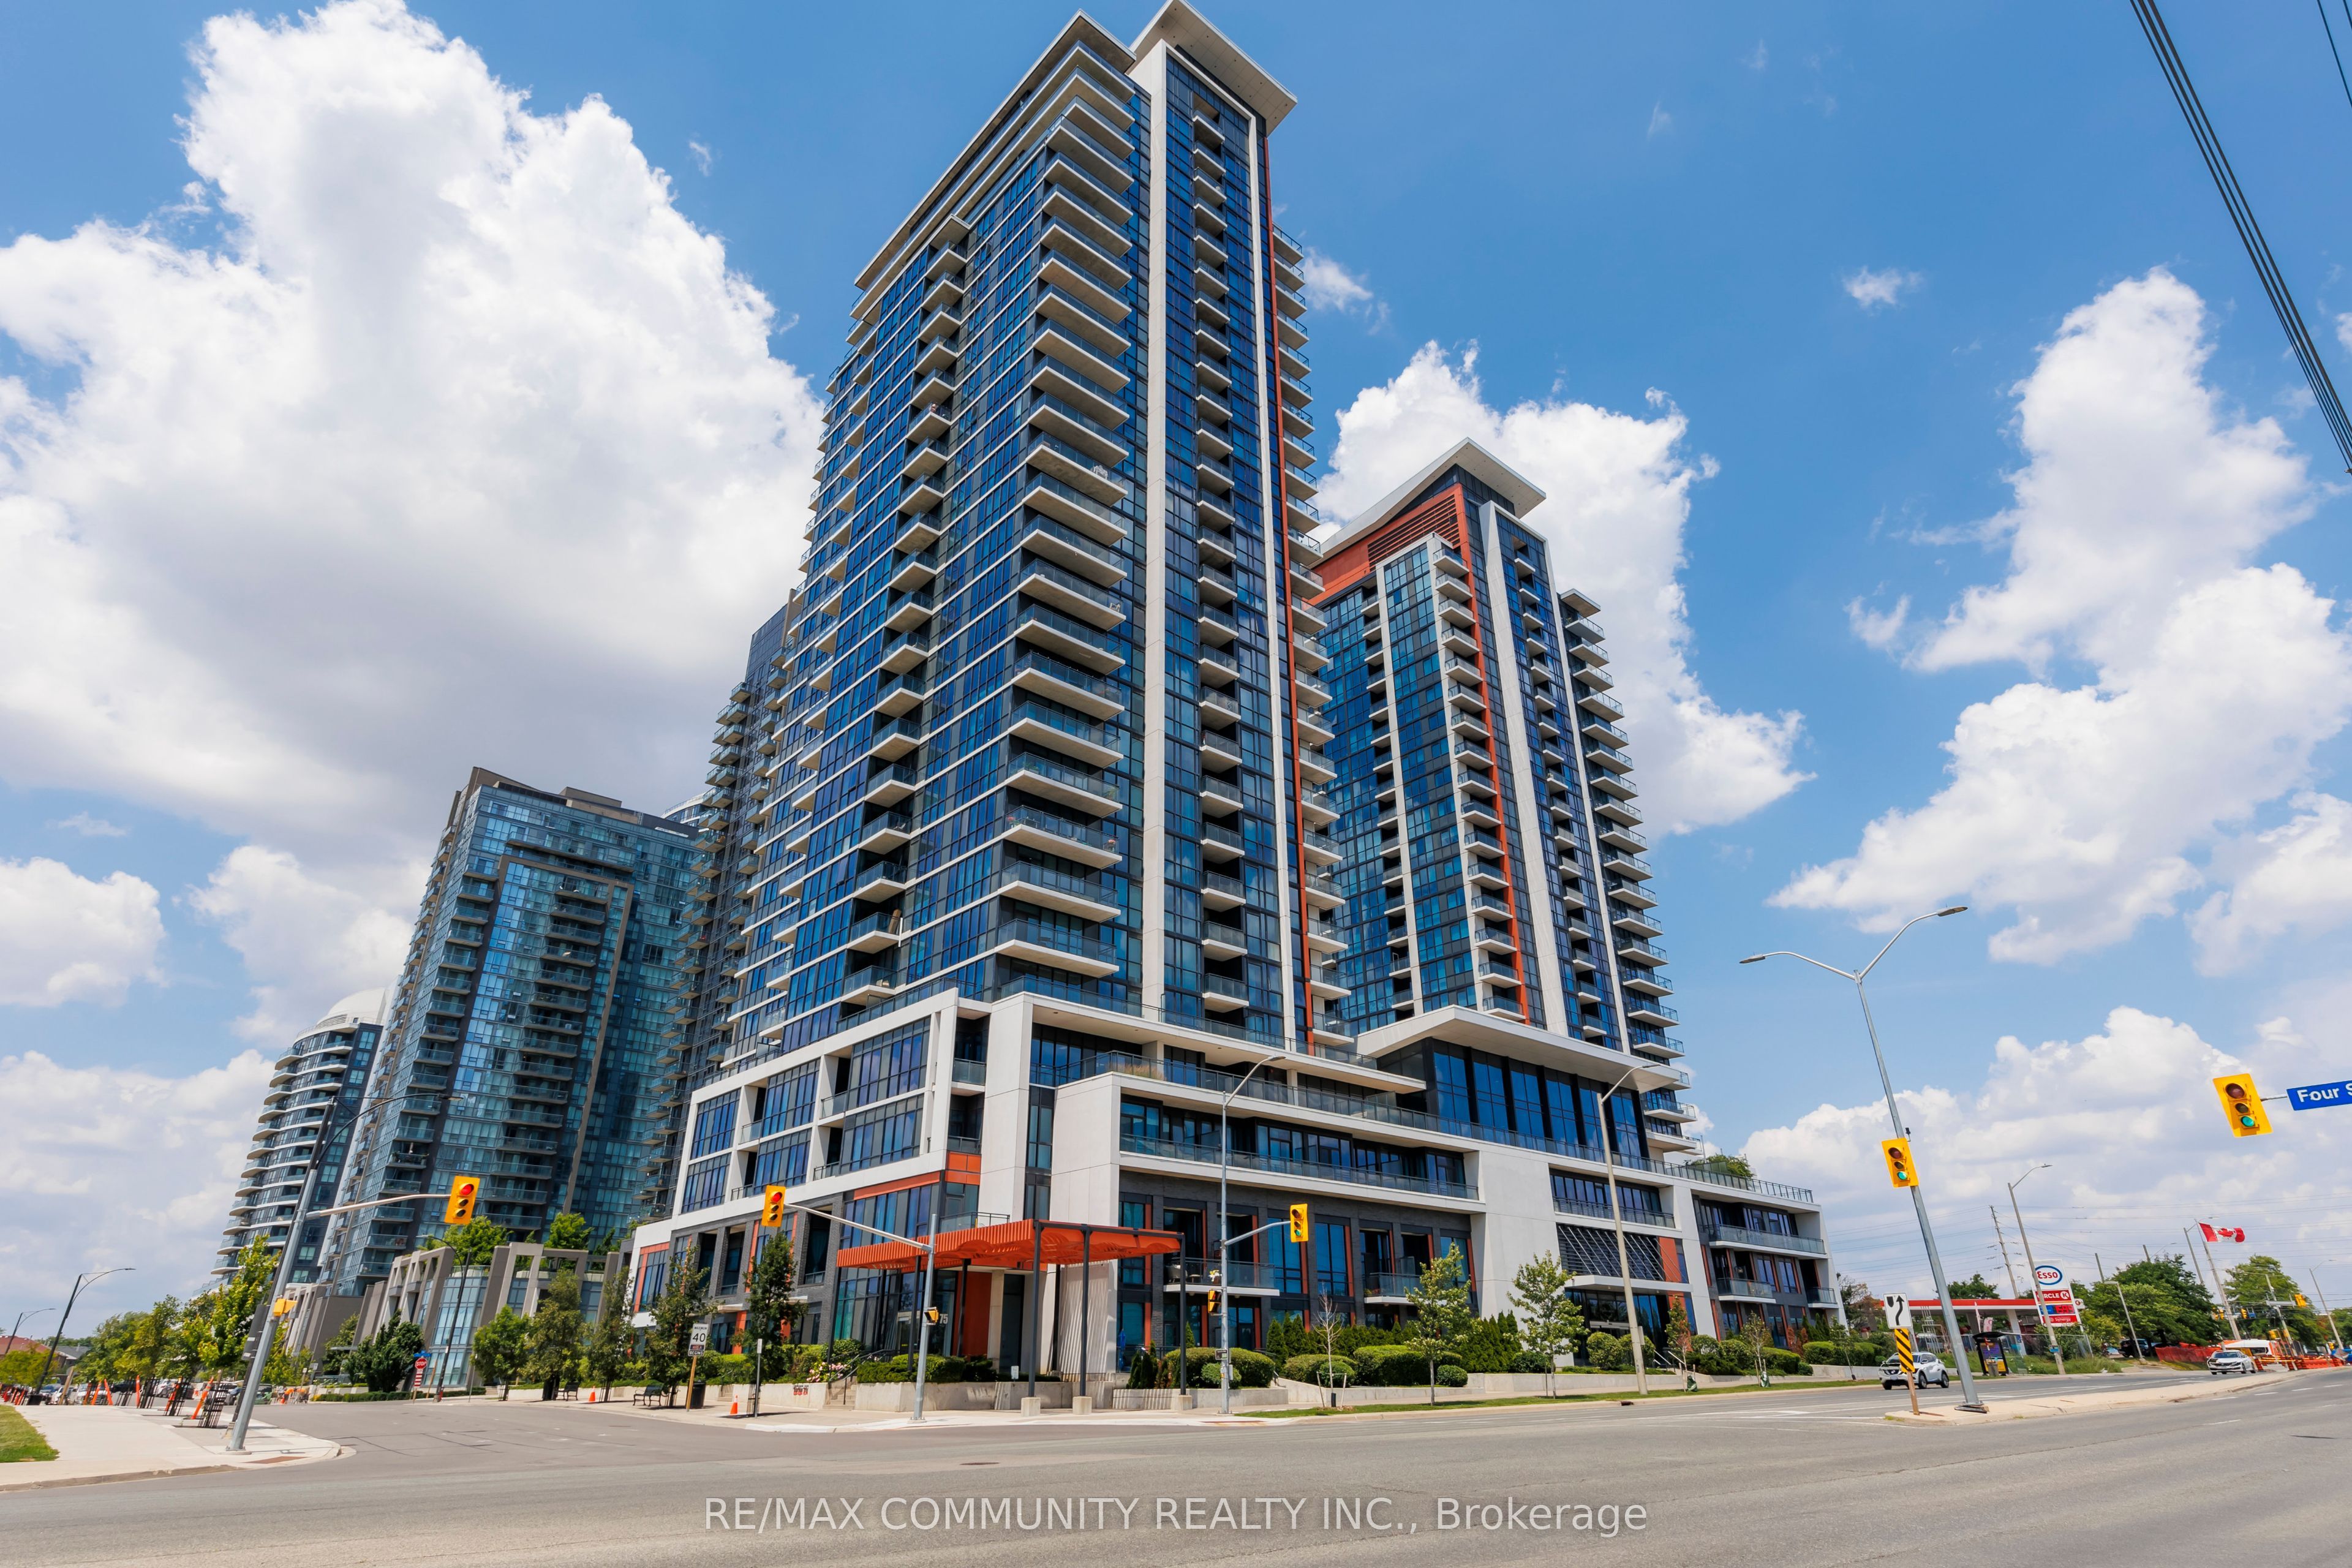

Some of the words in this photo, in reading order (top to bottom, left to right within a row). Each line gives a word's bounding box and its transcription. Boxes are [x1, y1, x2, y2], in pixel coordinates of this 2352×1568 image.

[2297, 1088, 2339, 1102] Four
[940, 1314, 948, 1324] 75
[693, 1333, 706, 1342] 40
